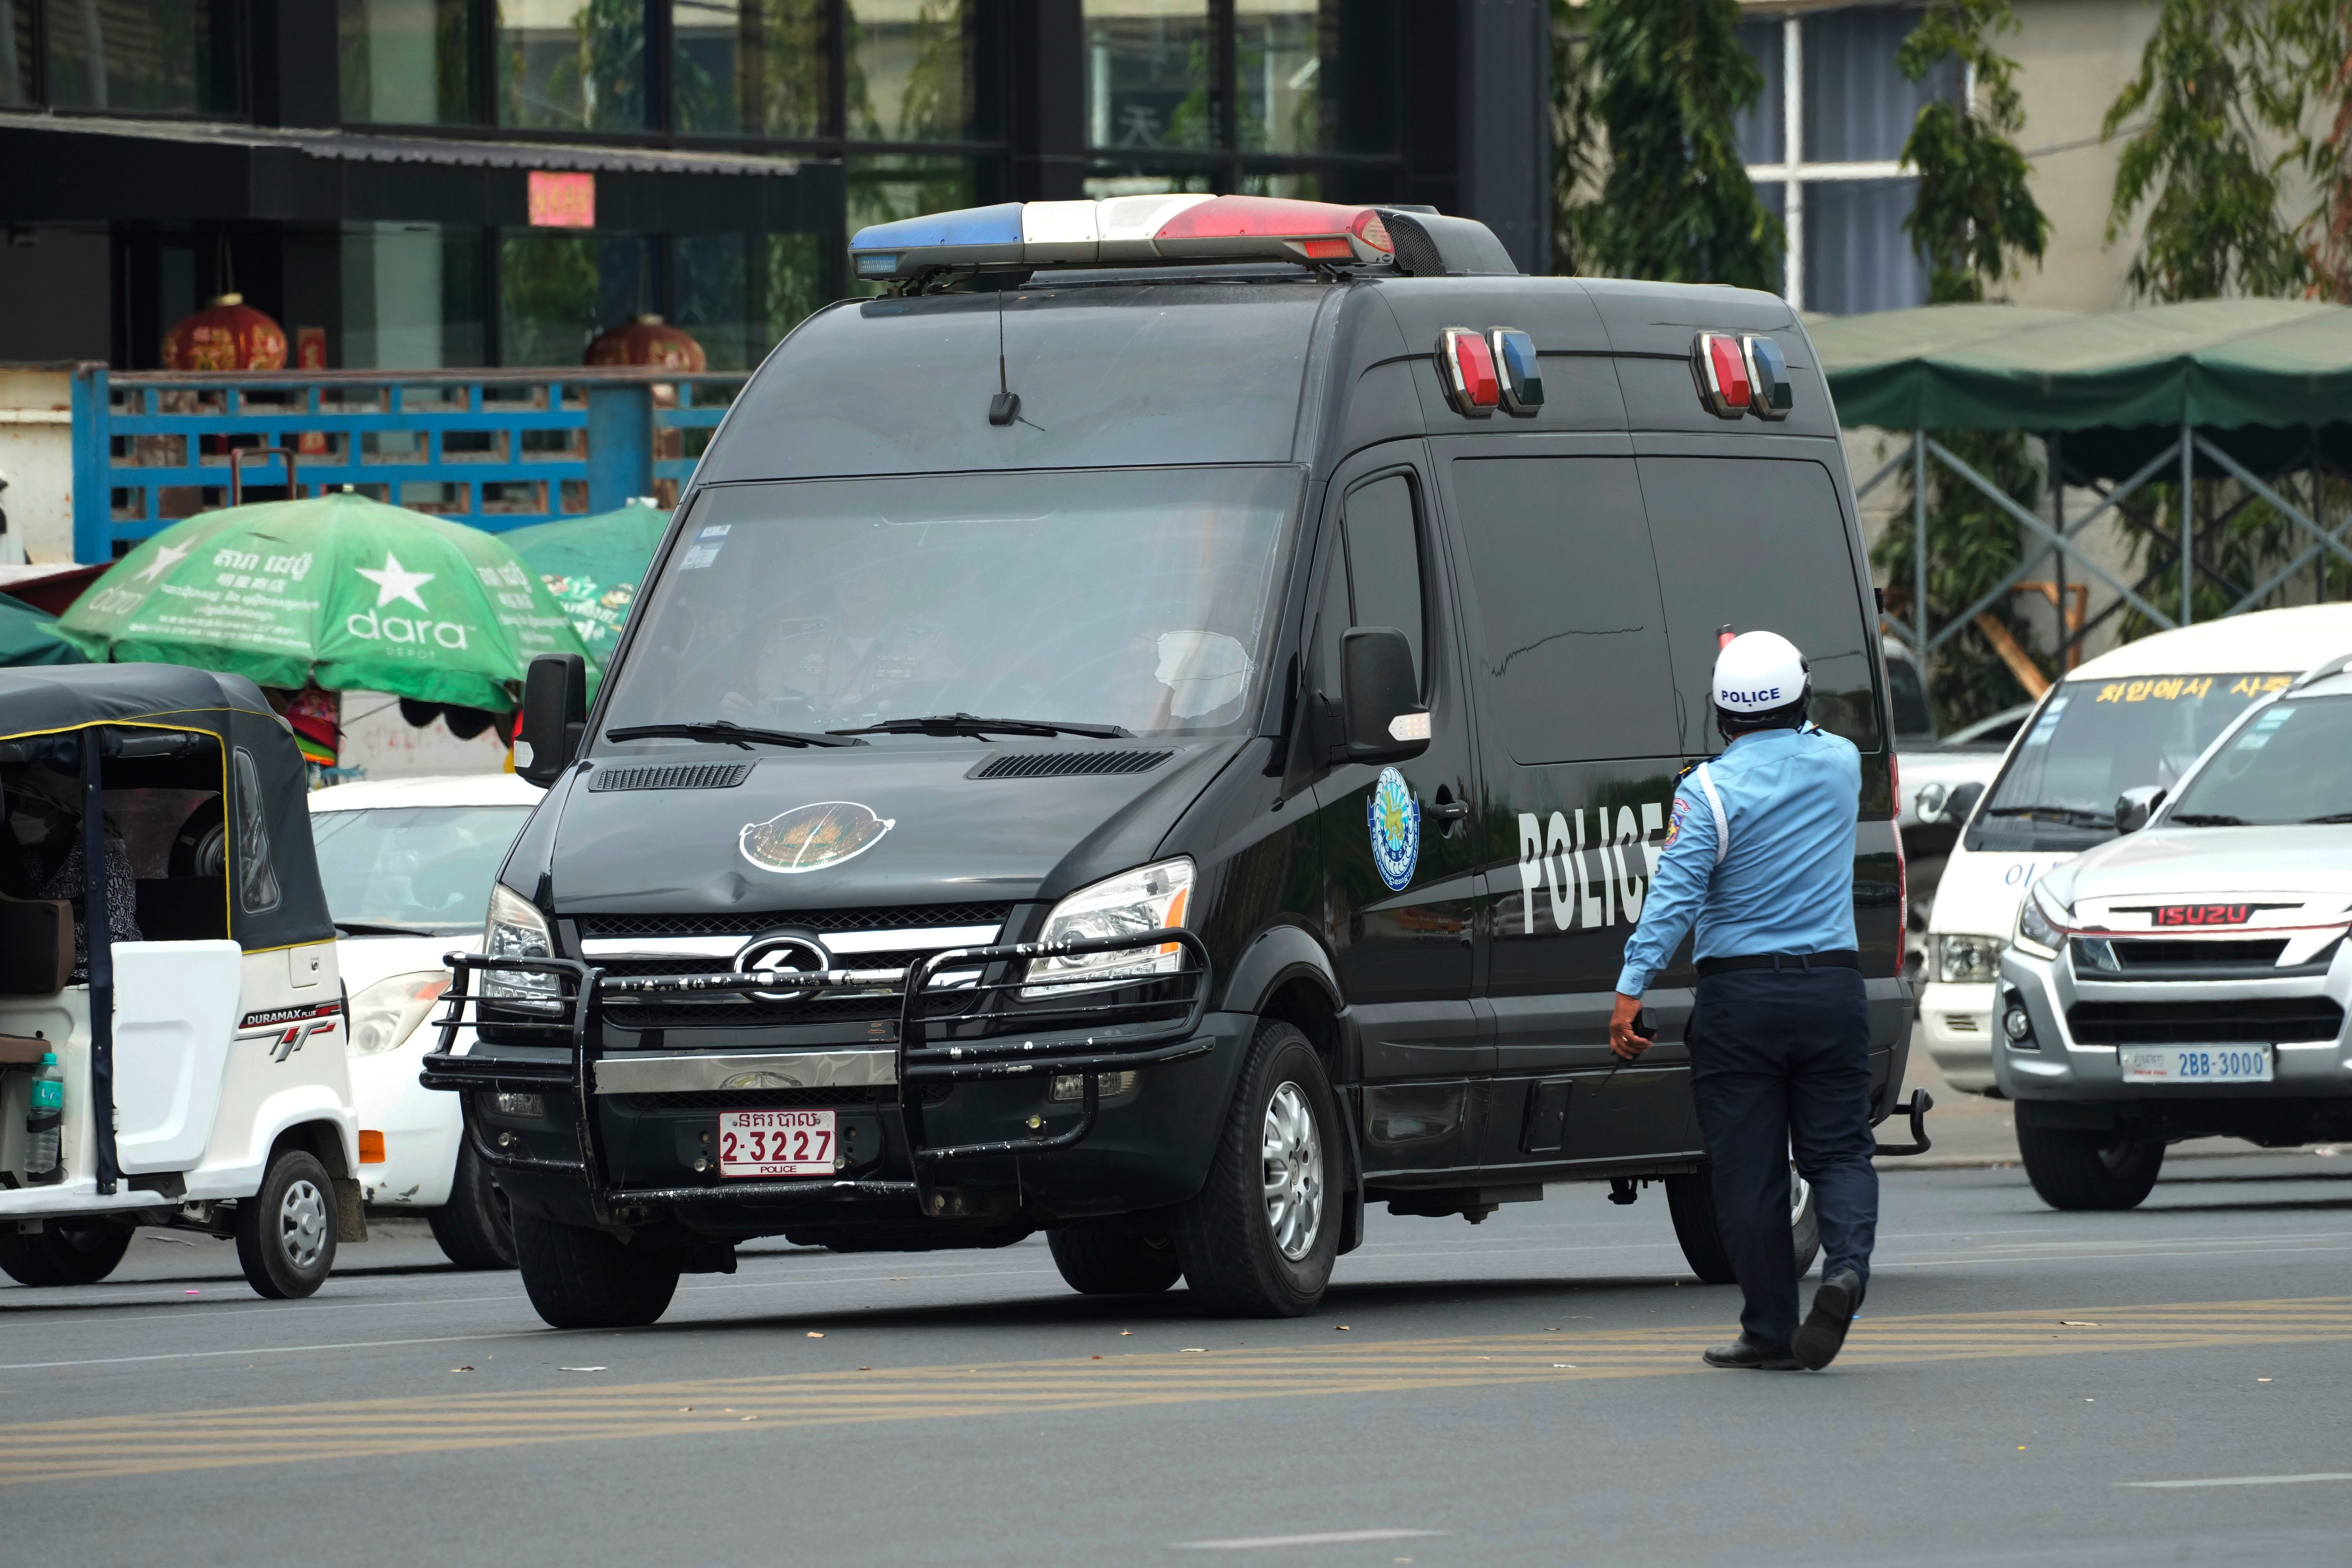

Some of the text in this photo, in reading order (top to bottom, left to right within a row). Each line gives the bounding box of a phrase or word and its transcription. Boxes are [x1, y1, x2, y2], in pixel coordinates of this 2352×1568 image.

[347, 608, 468, 650] dara
[386, 647, 436, 659] DEPOT
[1722, 687, 1780, 703] POLICE
[2158, 905, 2246, 925] ISUZU
[247, 1009, 301, 1025] DURAMAX
[2179, 1052, 2262, 1076] 2BB-3000
[739, 1112, 818, 1127] នគរបាល
